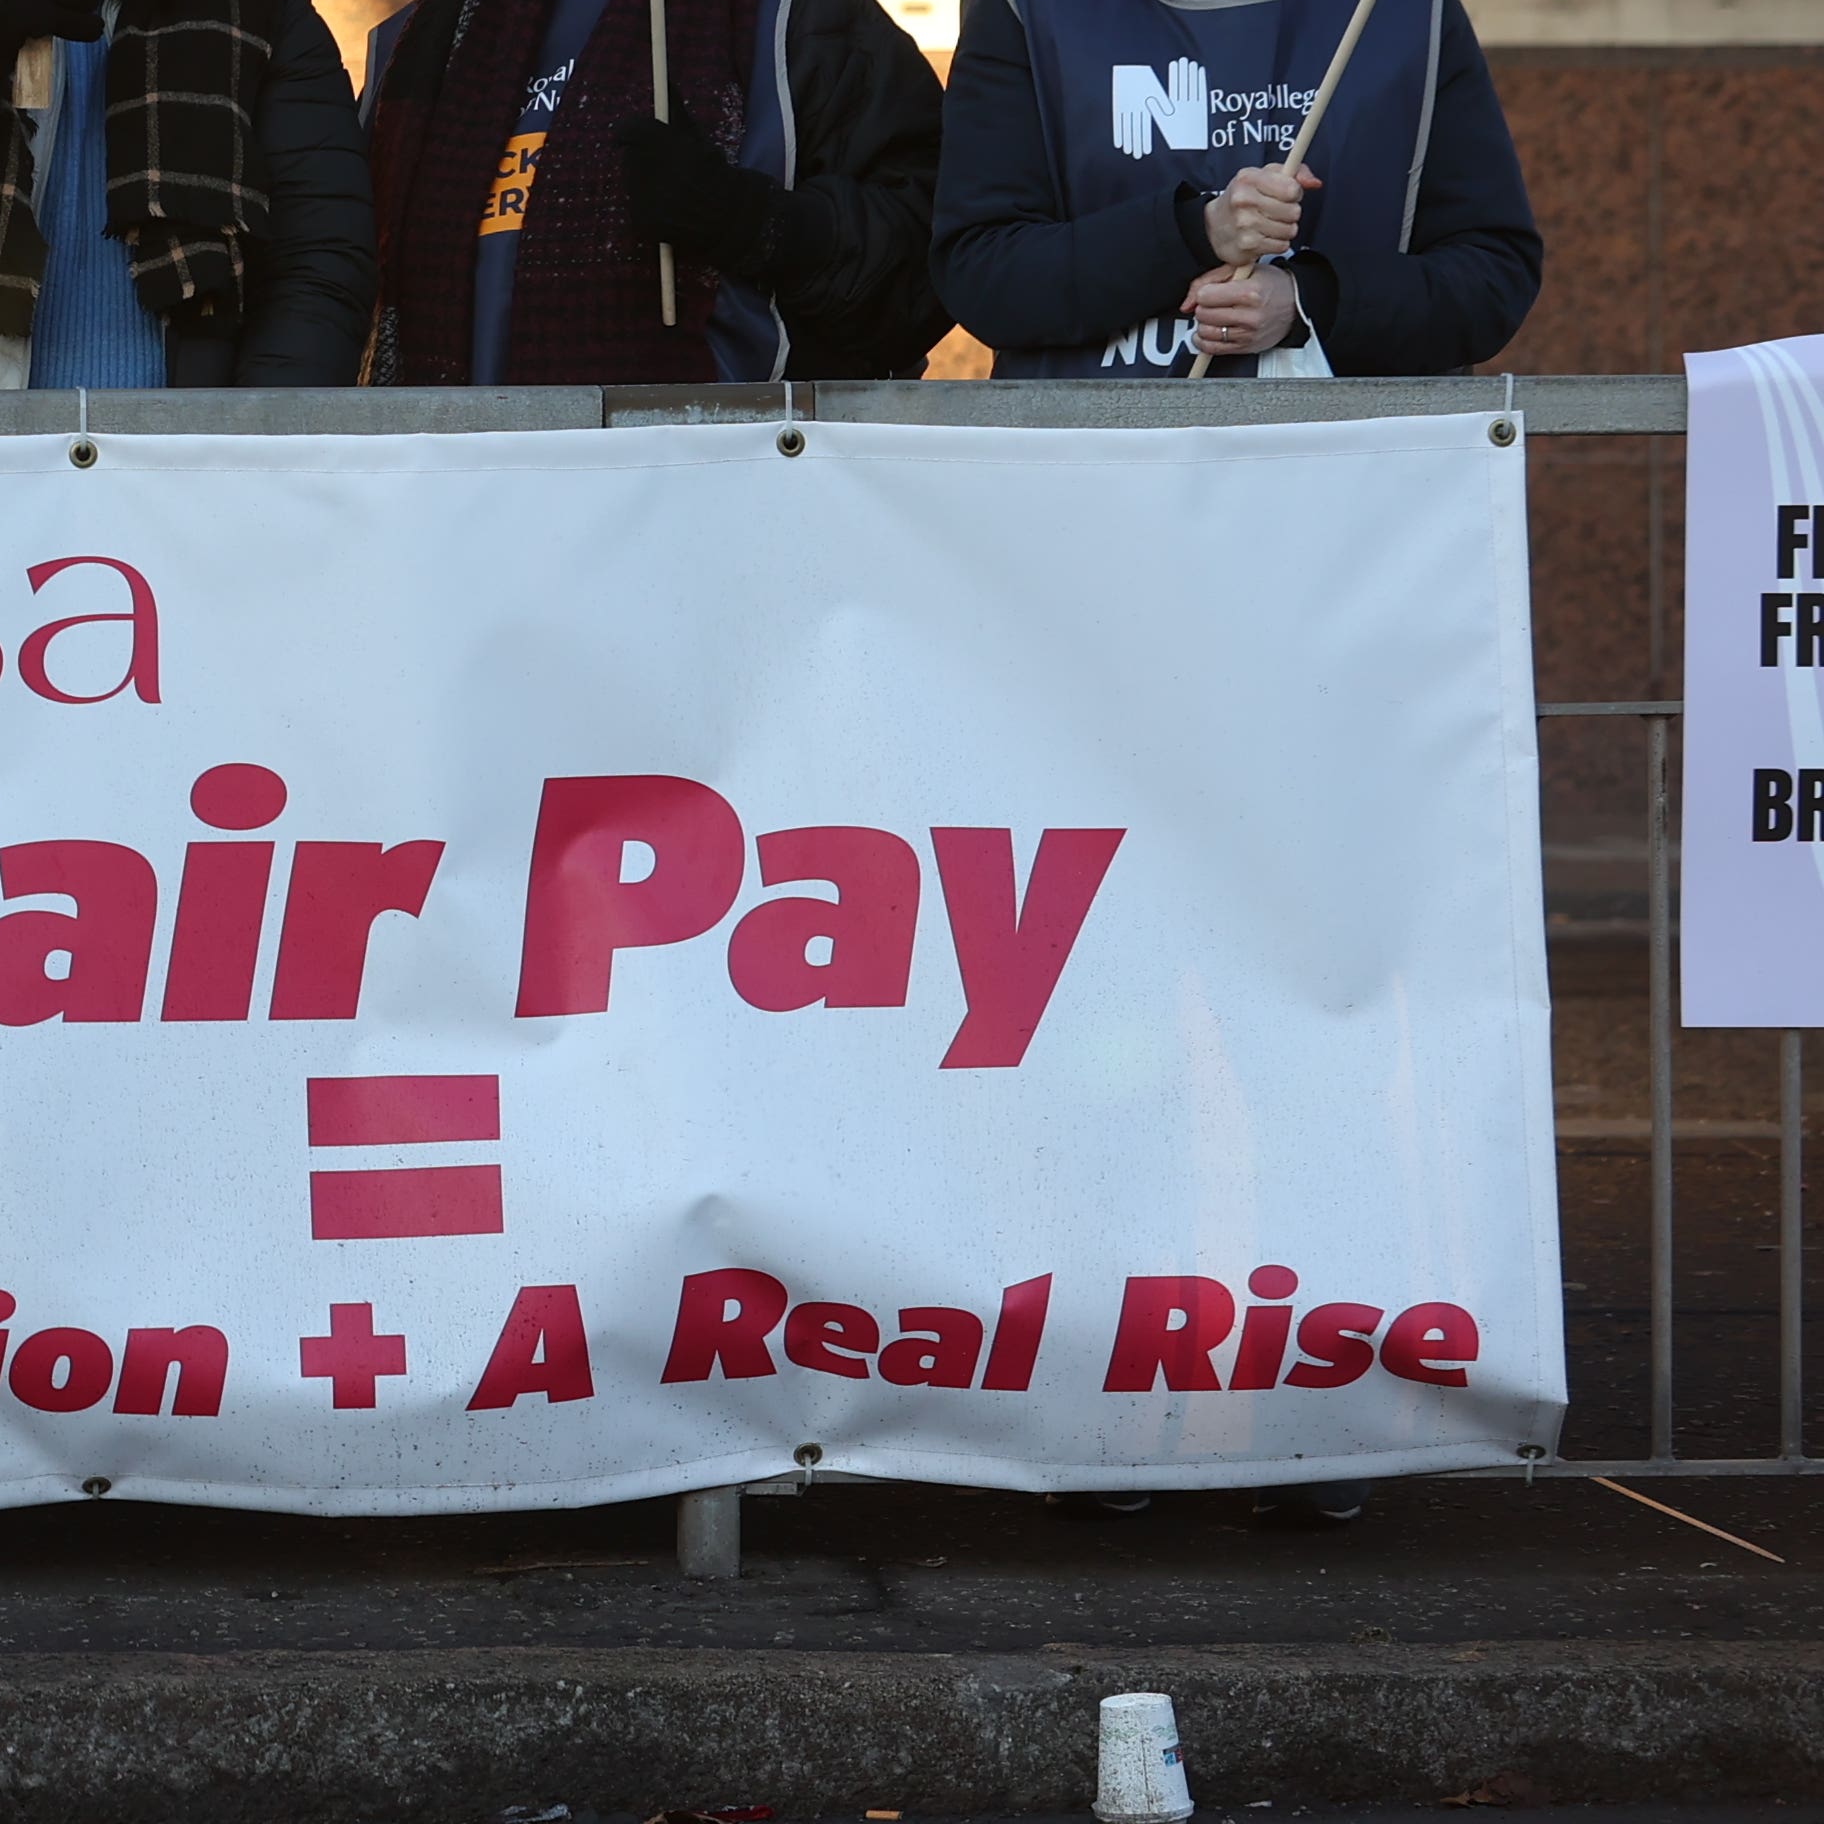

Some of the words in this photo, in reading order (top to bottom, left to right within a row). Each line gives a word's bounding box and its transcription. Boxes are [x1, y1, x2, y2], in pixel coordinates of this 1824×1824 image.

[1212, 120, 1237, 148] of
[514, 774, 1127, 1070] Pay
[466, 1283, 595, 1411] A
[660, 1266, 1052, 1393] Real
[1102, 1264, 1478, 1392] Rise
